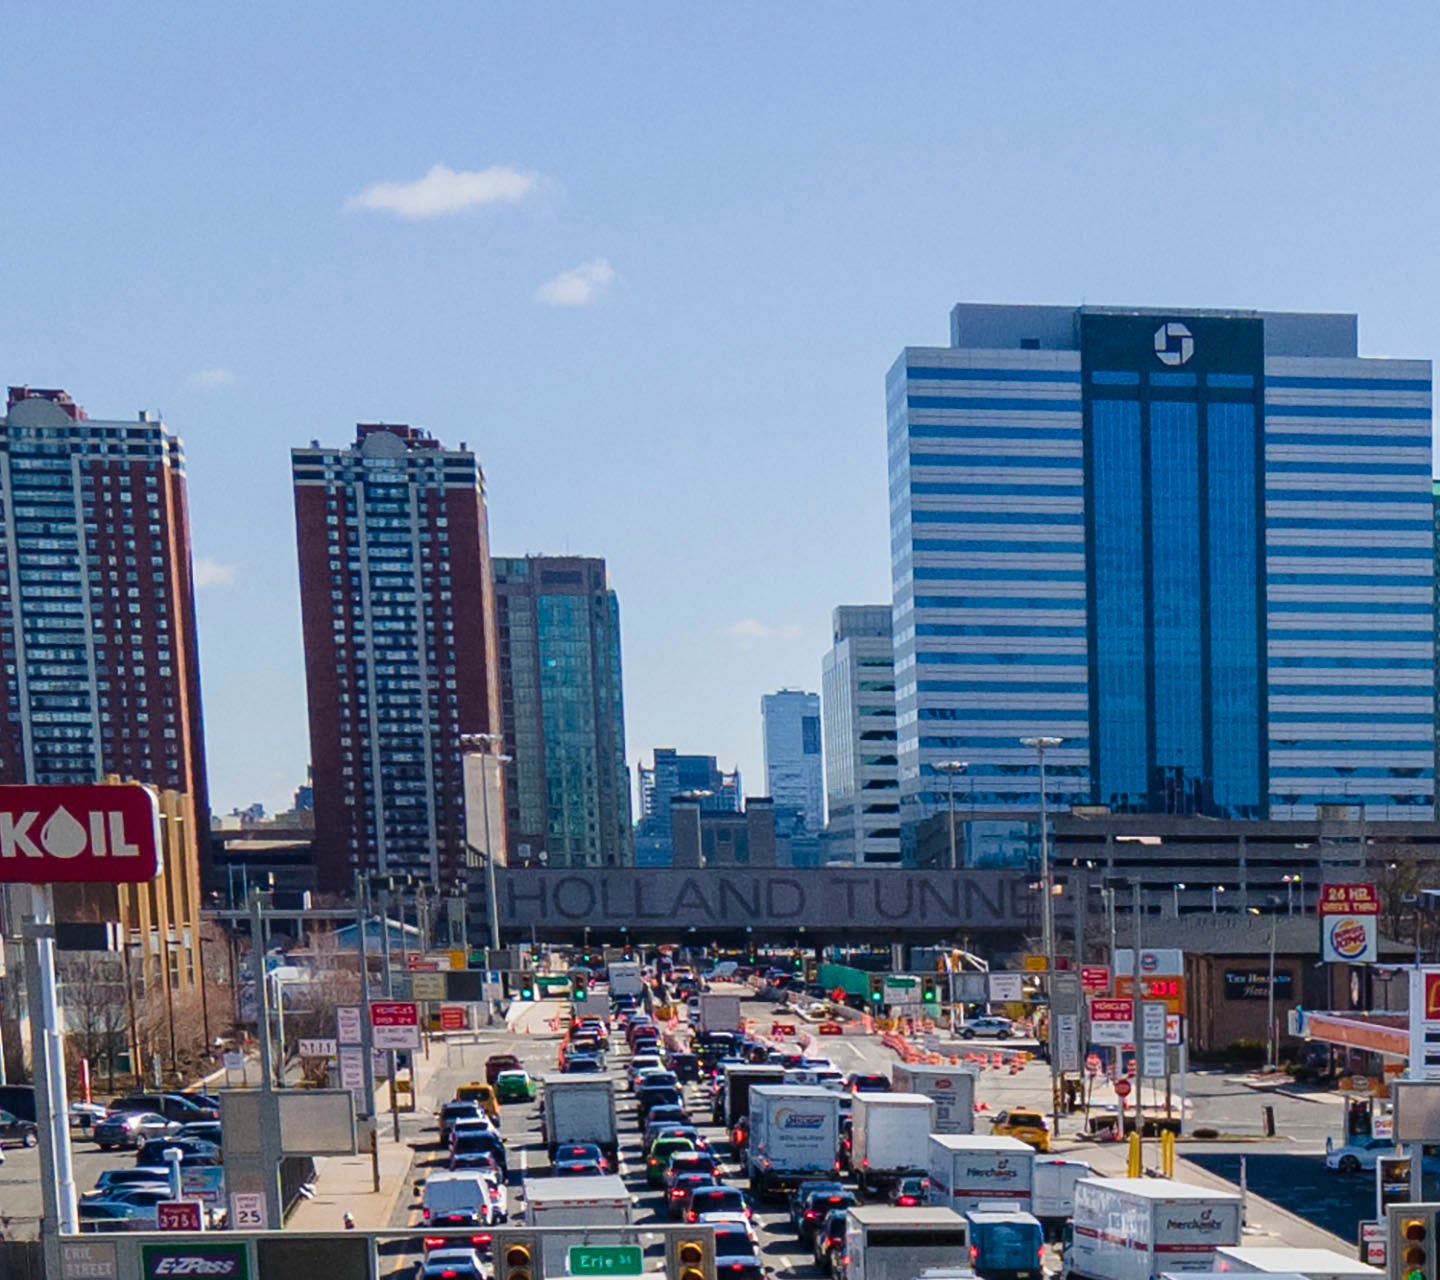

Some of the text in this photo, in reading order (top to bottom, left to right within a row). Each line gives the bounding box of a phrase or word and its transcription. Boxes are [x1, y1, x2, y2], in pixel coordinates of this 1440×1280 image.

[507, 877, 806, 921] HOLLAND
[239, 1210, 261, 1224] 25
[581, 1254, 613, 1268] Erie
